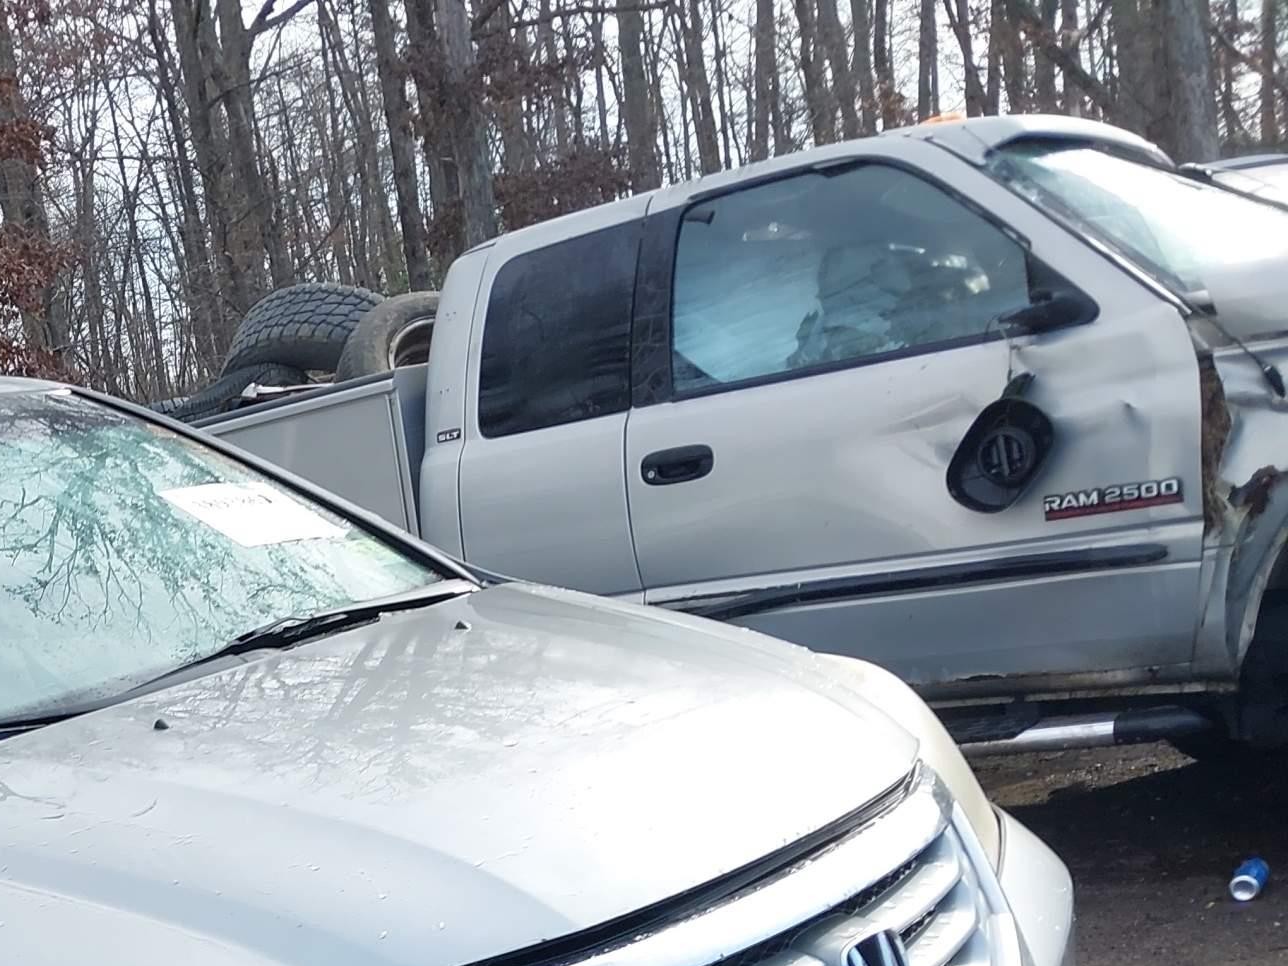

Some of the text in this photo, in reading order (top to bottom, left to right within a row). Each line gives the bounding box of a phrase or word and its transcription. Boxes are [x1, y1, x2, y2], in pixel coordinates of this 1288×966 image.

[438, 430, 460, 442] SLT
[1044, 478, 1179, 511] RAM 2500
